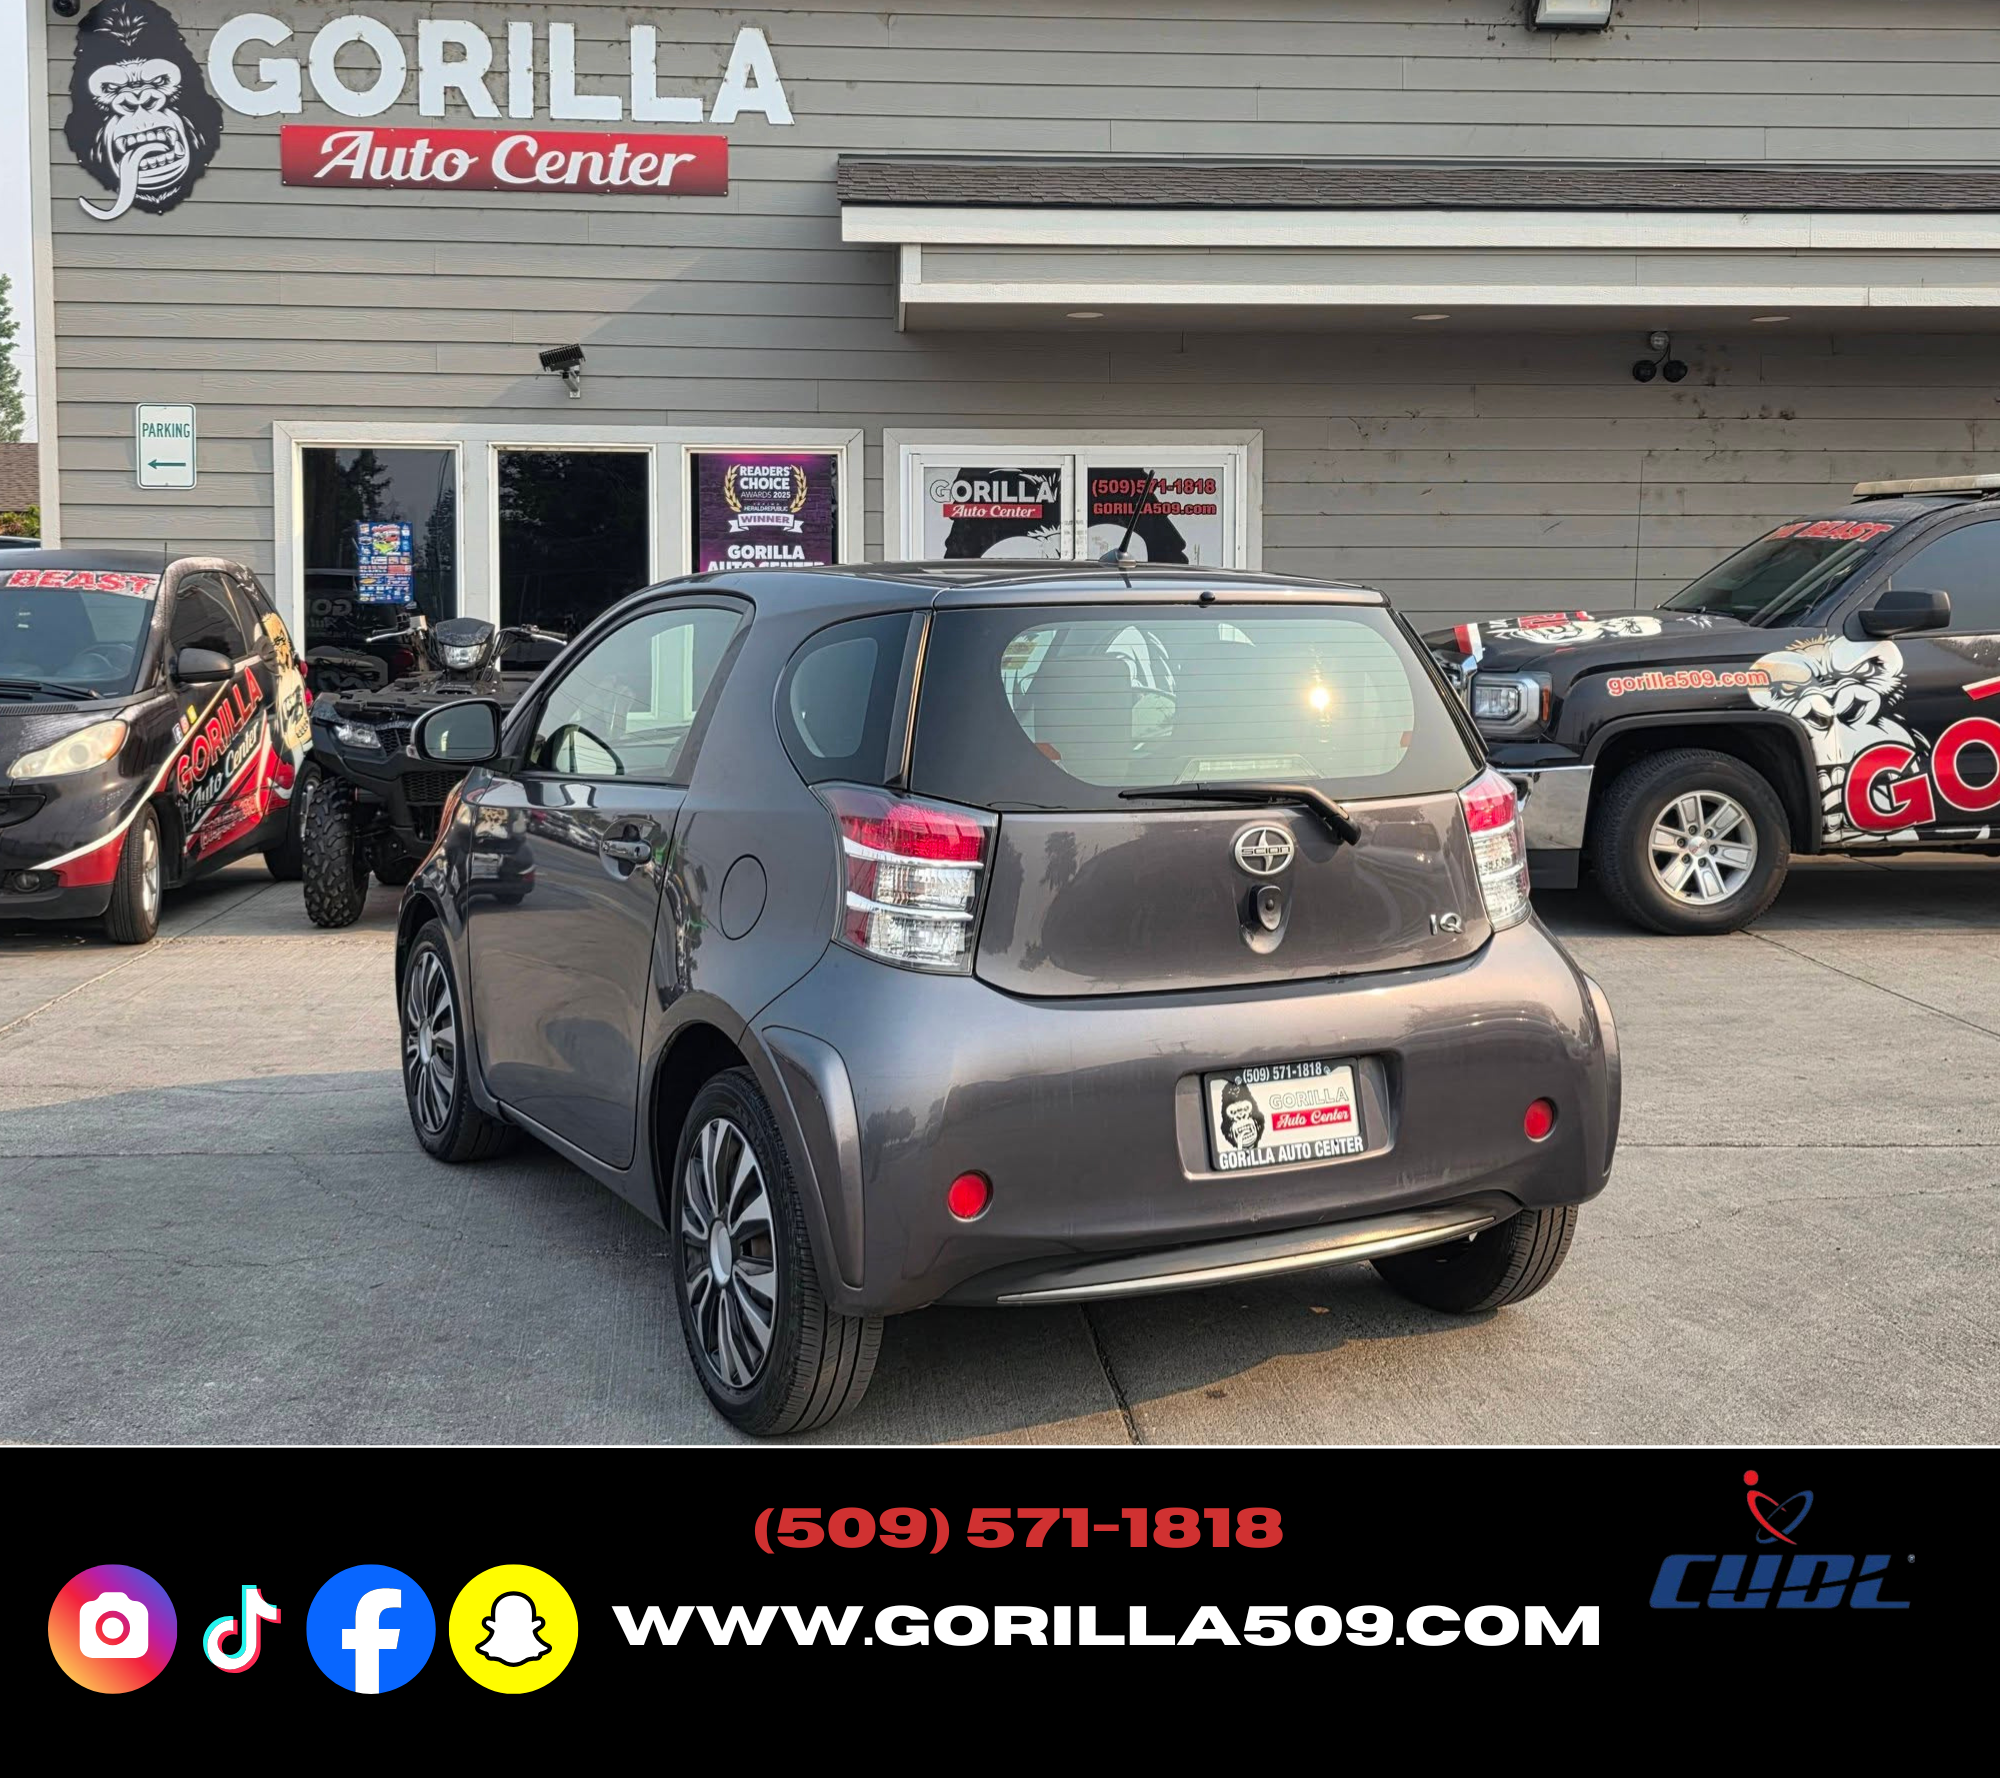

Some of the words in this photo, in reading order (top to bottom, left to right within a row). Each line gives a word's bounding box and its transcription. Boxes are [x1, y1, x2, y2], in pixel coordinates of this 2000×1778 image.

[207, 12, 795, 126] GORILLA
[313, 130, 478, 182] Auto
[492, 133, 697, 187] Center
[142, 422, 191, 438] PARKING
[740, 477, 790, 490] CHOICE
[930, 481, 1055, 504] GORILLA
[740, 491, 772, 499] AWARDS
[773, 491, 791, 499] 2025
[740, 515, 790, 524] WINNER
[951, 504, 987, 518] Auto
[989, 505, 1036, 518] Center
[1093, 502, 1217, 515] GORILA509.com
[727, 544, 806, 560] GORILLA
[5, 569, 160, 595] BEAST
[1607, 669, 1770, 697] gorilla509.com
[177, 666, 264, 796] GORILLA
[225, 720, 260, 779] Center
[1242, 1067, 1270, 1083] (509)
[1272, 1061, 1322, 1080] 571-1818
[1269, 1087, 1350, 1110] GORILLA
[1275, 1113, 1308, 1129] Auto
[1310, 1107, 1349, 1125] Center
[1219, 1147, 1275, 1170] GORILLA
[1278, 1142, 1312, 1163] AUTO
[1314, 1135, 1364, 1157] CENTER
